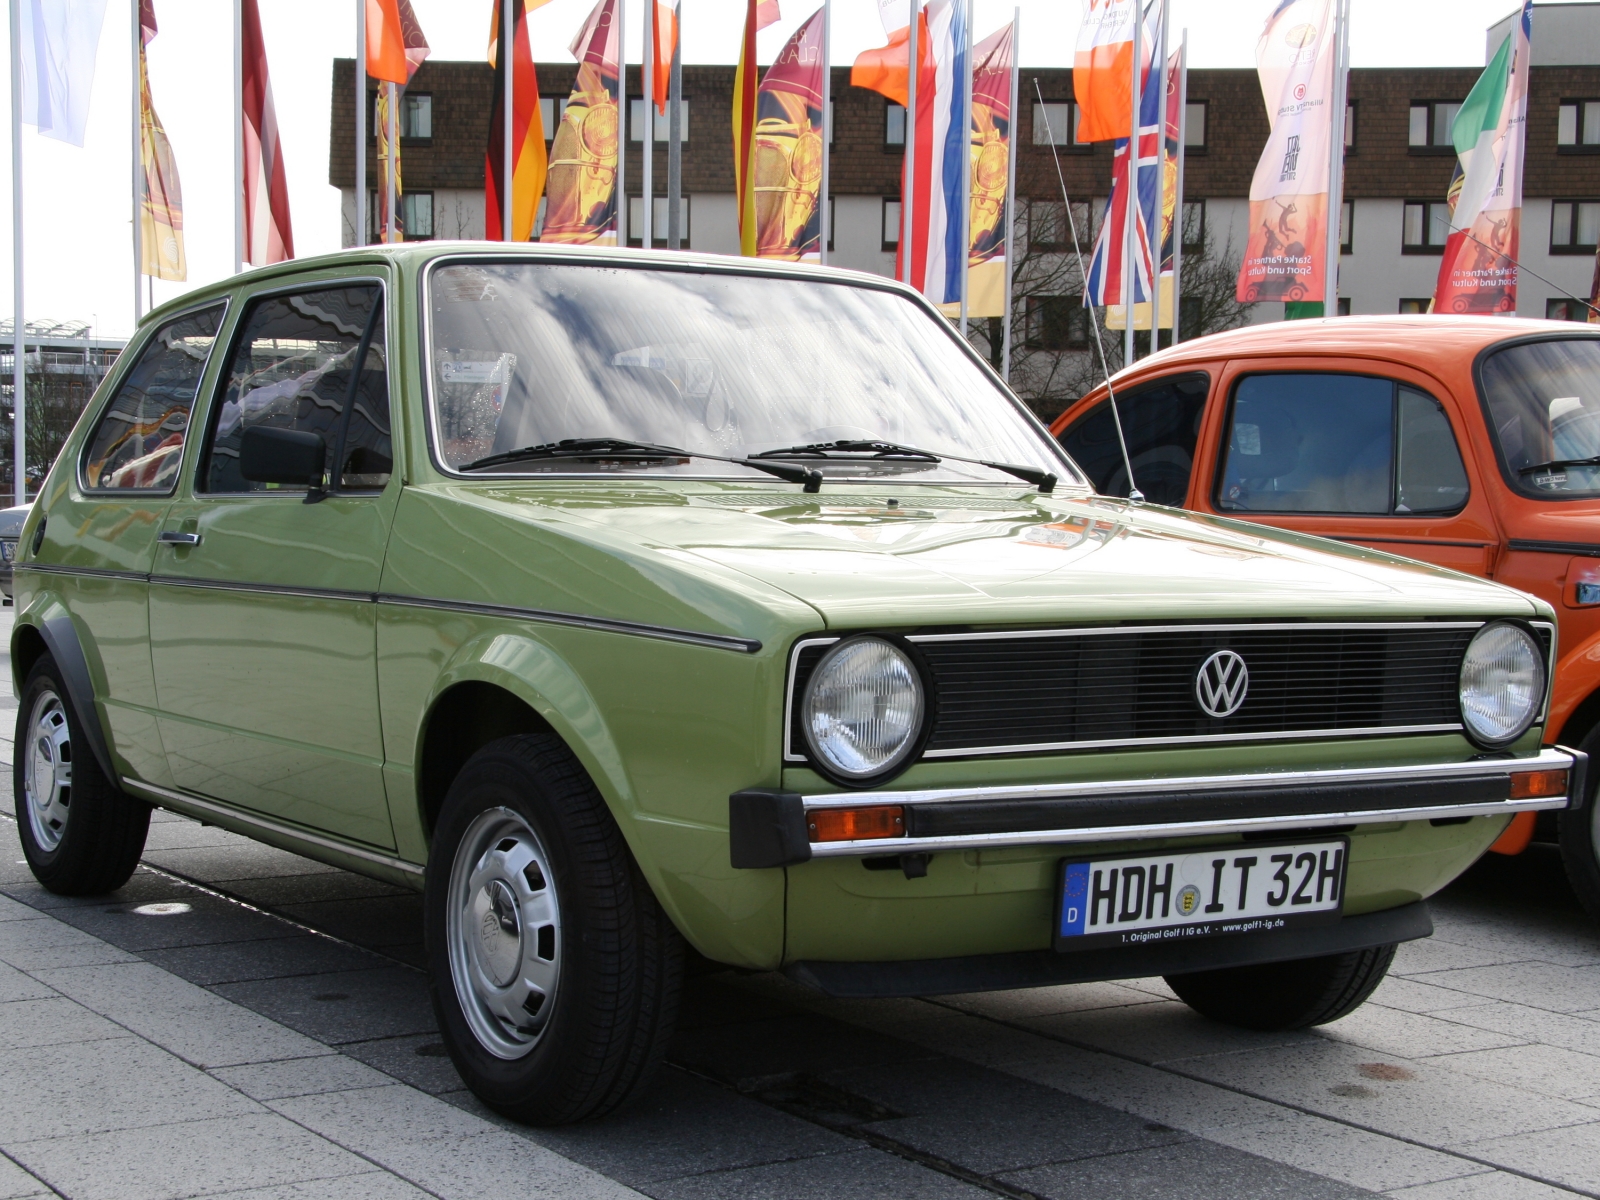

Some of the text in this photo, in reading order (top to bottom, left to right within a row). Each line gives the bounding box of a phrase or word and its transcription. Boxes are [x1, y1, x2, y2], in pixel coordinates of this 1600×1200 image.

[1196, 651, 1247, 717] VW
[1090, 863, 1174, 926] HDH
[1204, 856, 1258, 914] IT
[1266, 848, 1343, 907] 32H
[1067, 907, 1078, 923] D
[1121, 934, 1129, 943] 1.
[1130, 926, 1162, 943] Original
[1163, 927, 1180, 938] Golf
[1186, 926, 1195, 936] IG
[1196, 925, 1211, 935] e.V.
[1222, 918, 1285, 932] www.golf1-ig.de
